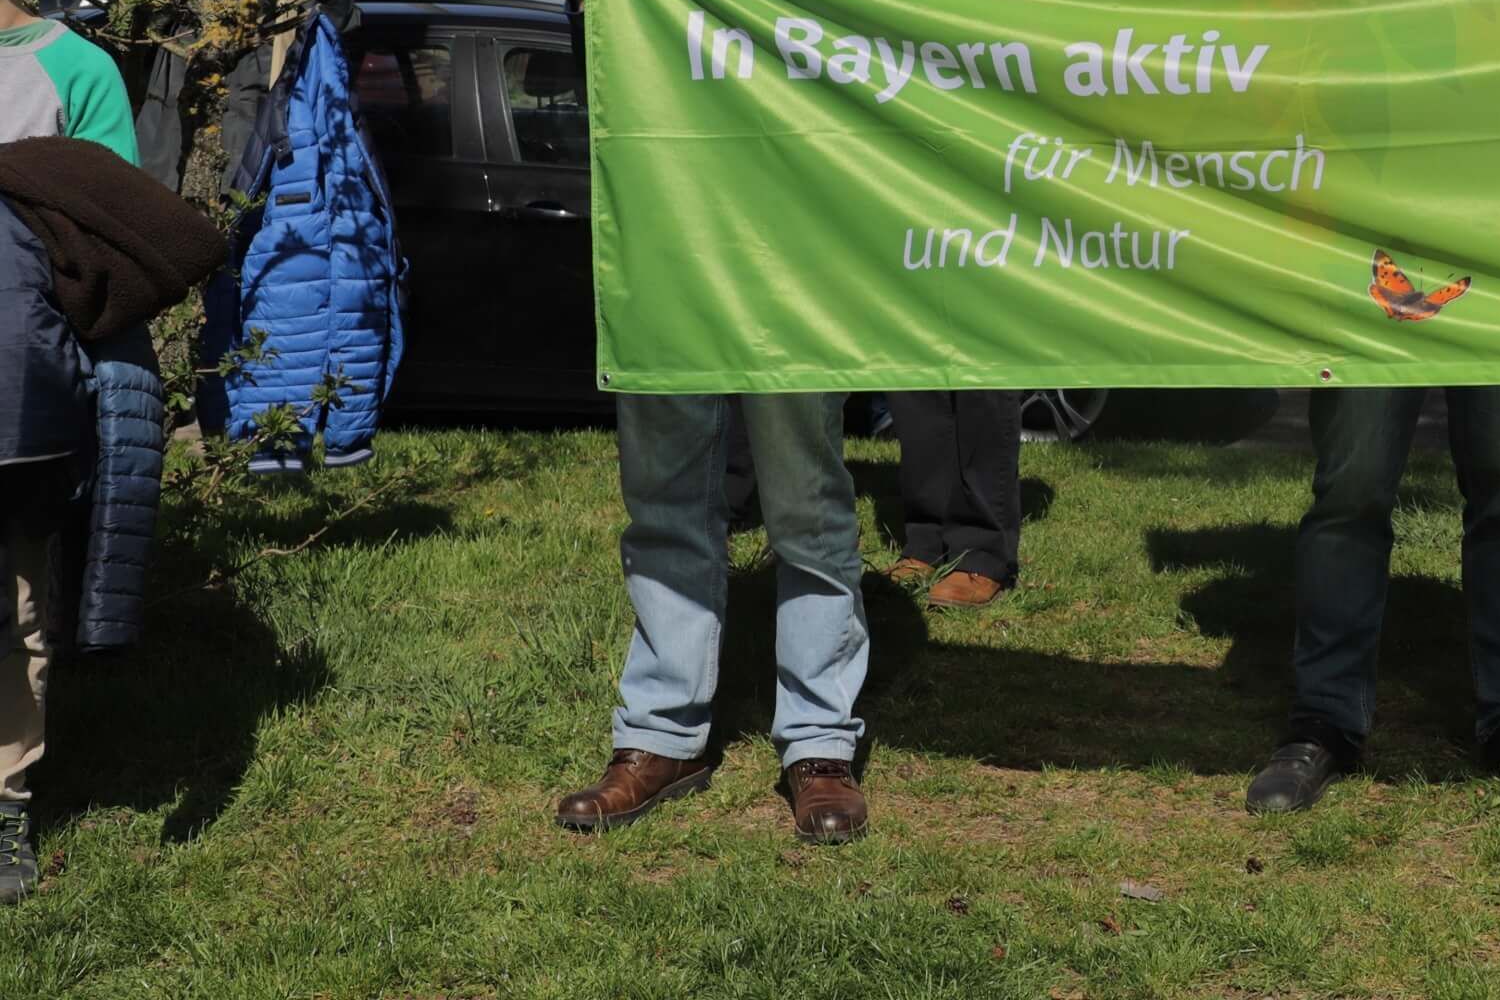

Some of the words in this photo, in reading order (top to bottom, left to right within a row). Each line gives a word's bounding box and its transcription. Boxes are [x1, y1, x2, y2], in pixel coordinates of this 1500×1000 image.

[687, 10, 754, 80] In
[774, 16, 1038, 103] Bayern
[1063, 27, 1270, 96] aktiv
[1003, 131, 1092, 193] für
[1104, 134, 1326, 191] Mensch
[903, 213, 1017, 270] und
[1033, 217, 1190, 270] Natur
